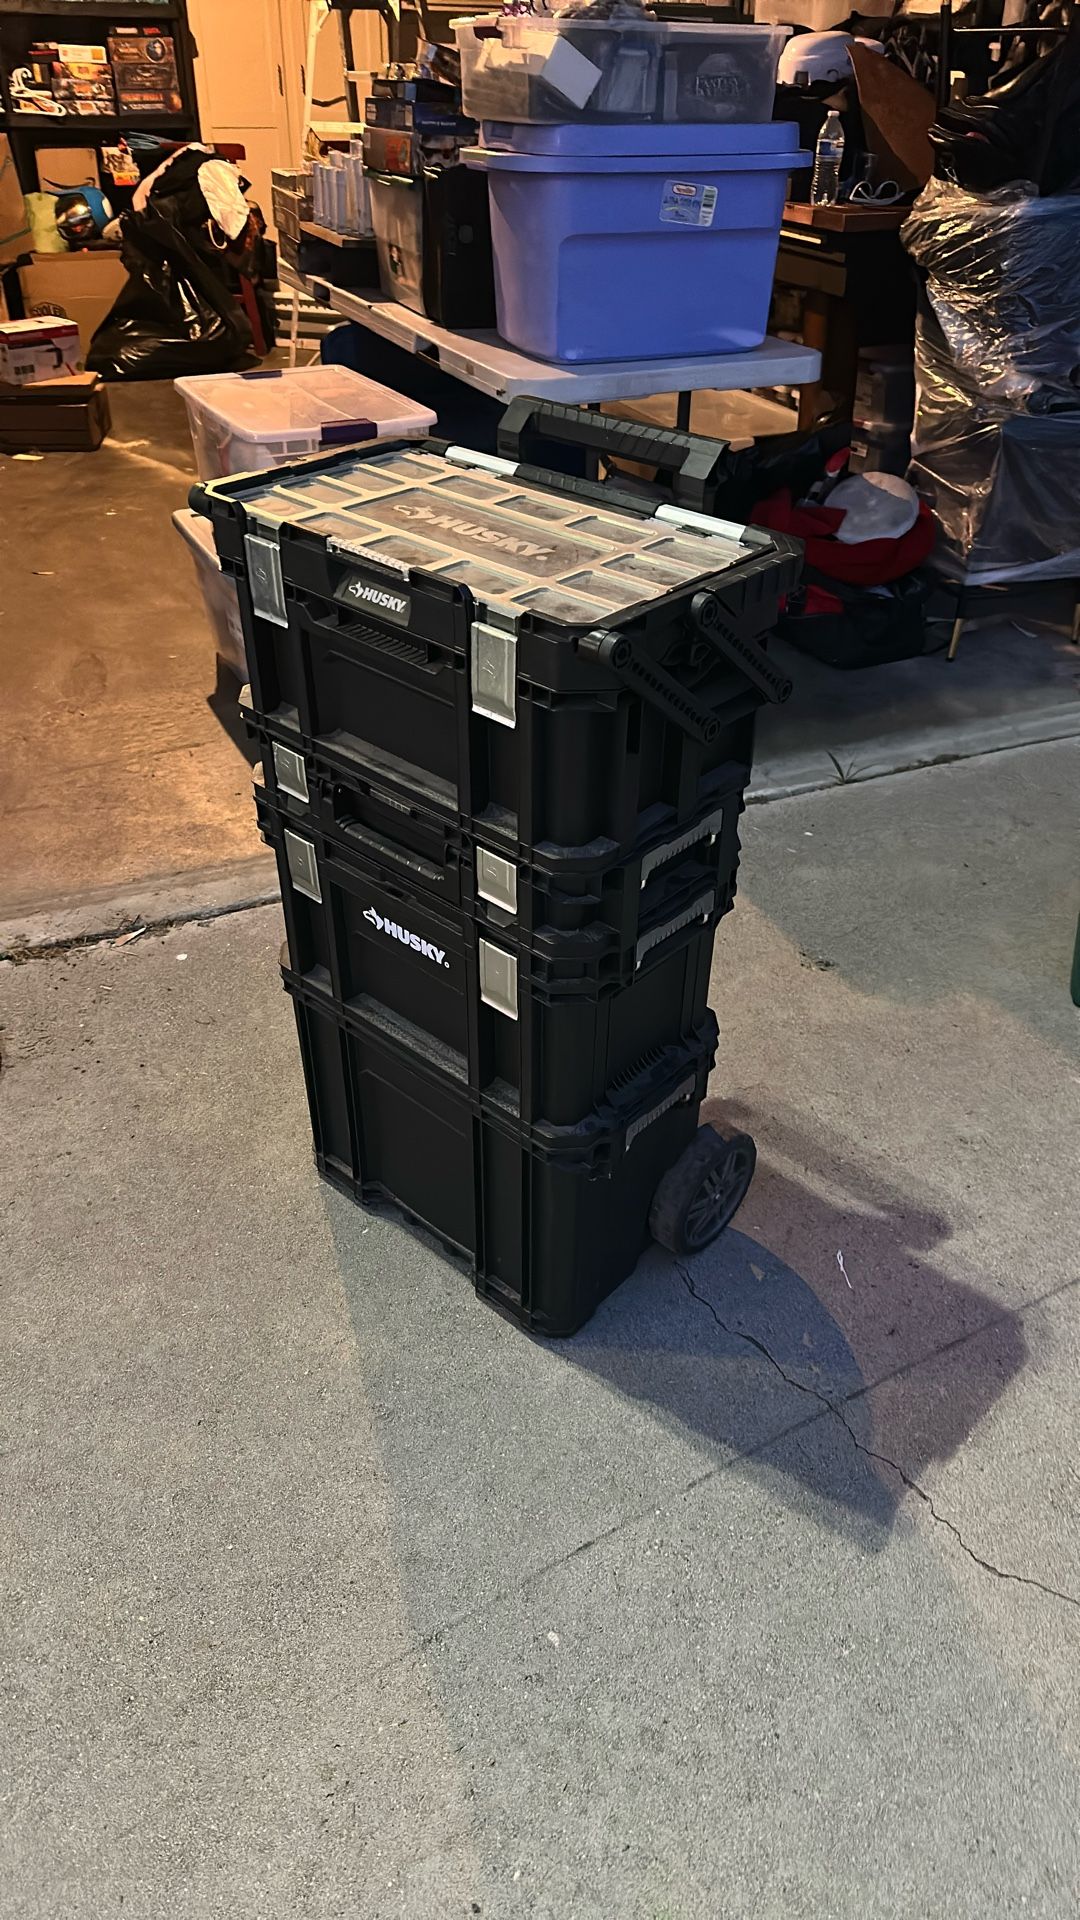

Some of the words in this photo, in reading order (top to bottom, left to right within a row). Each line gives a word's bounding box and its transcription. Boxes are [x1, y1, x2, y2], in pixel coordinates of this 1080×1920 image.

[426, 514, 556, 557] HUSKY
[362, 587, 407, 612] HUSKY
[383, 917, 446, 965] HUSKY
